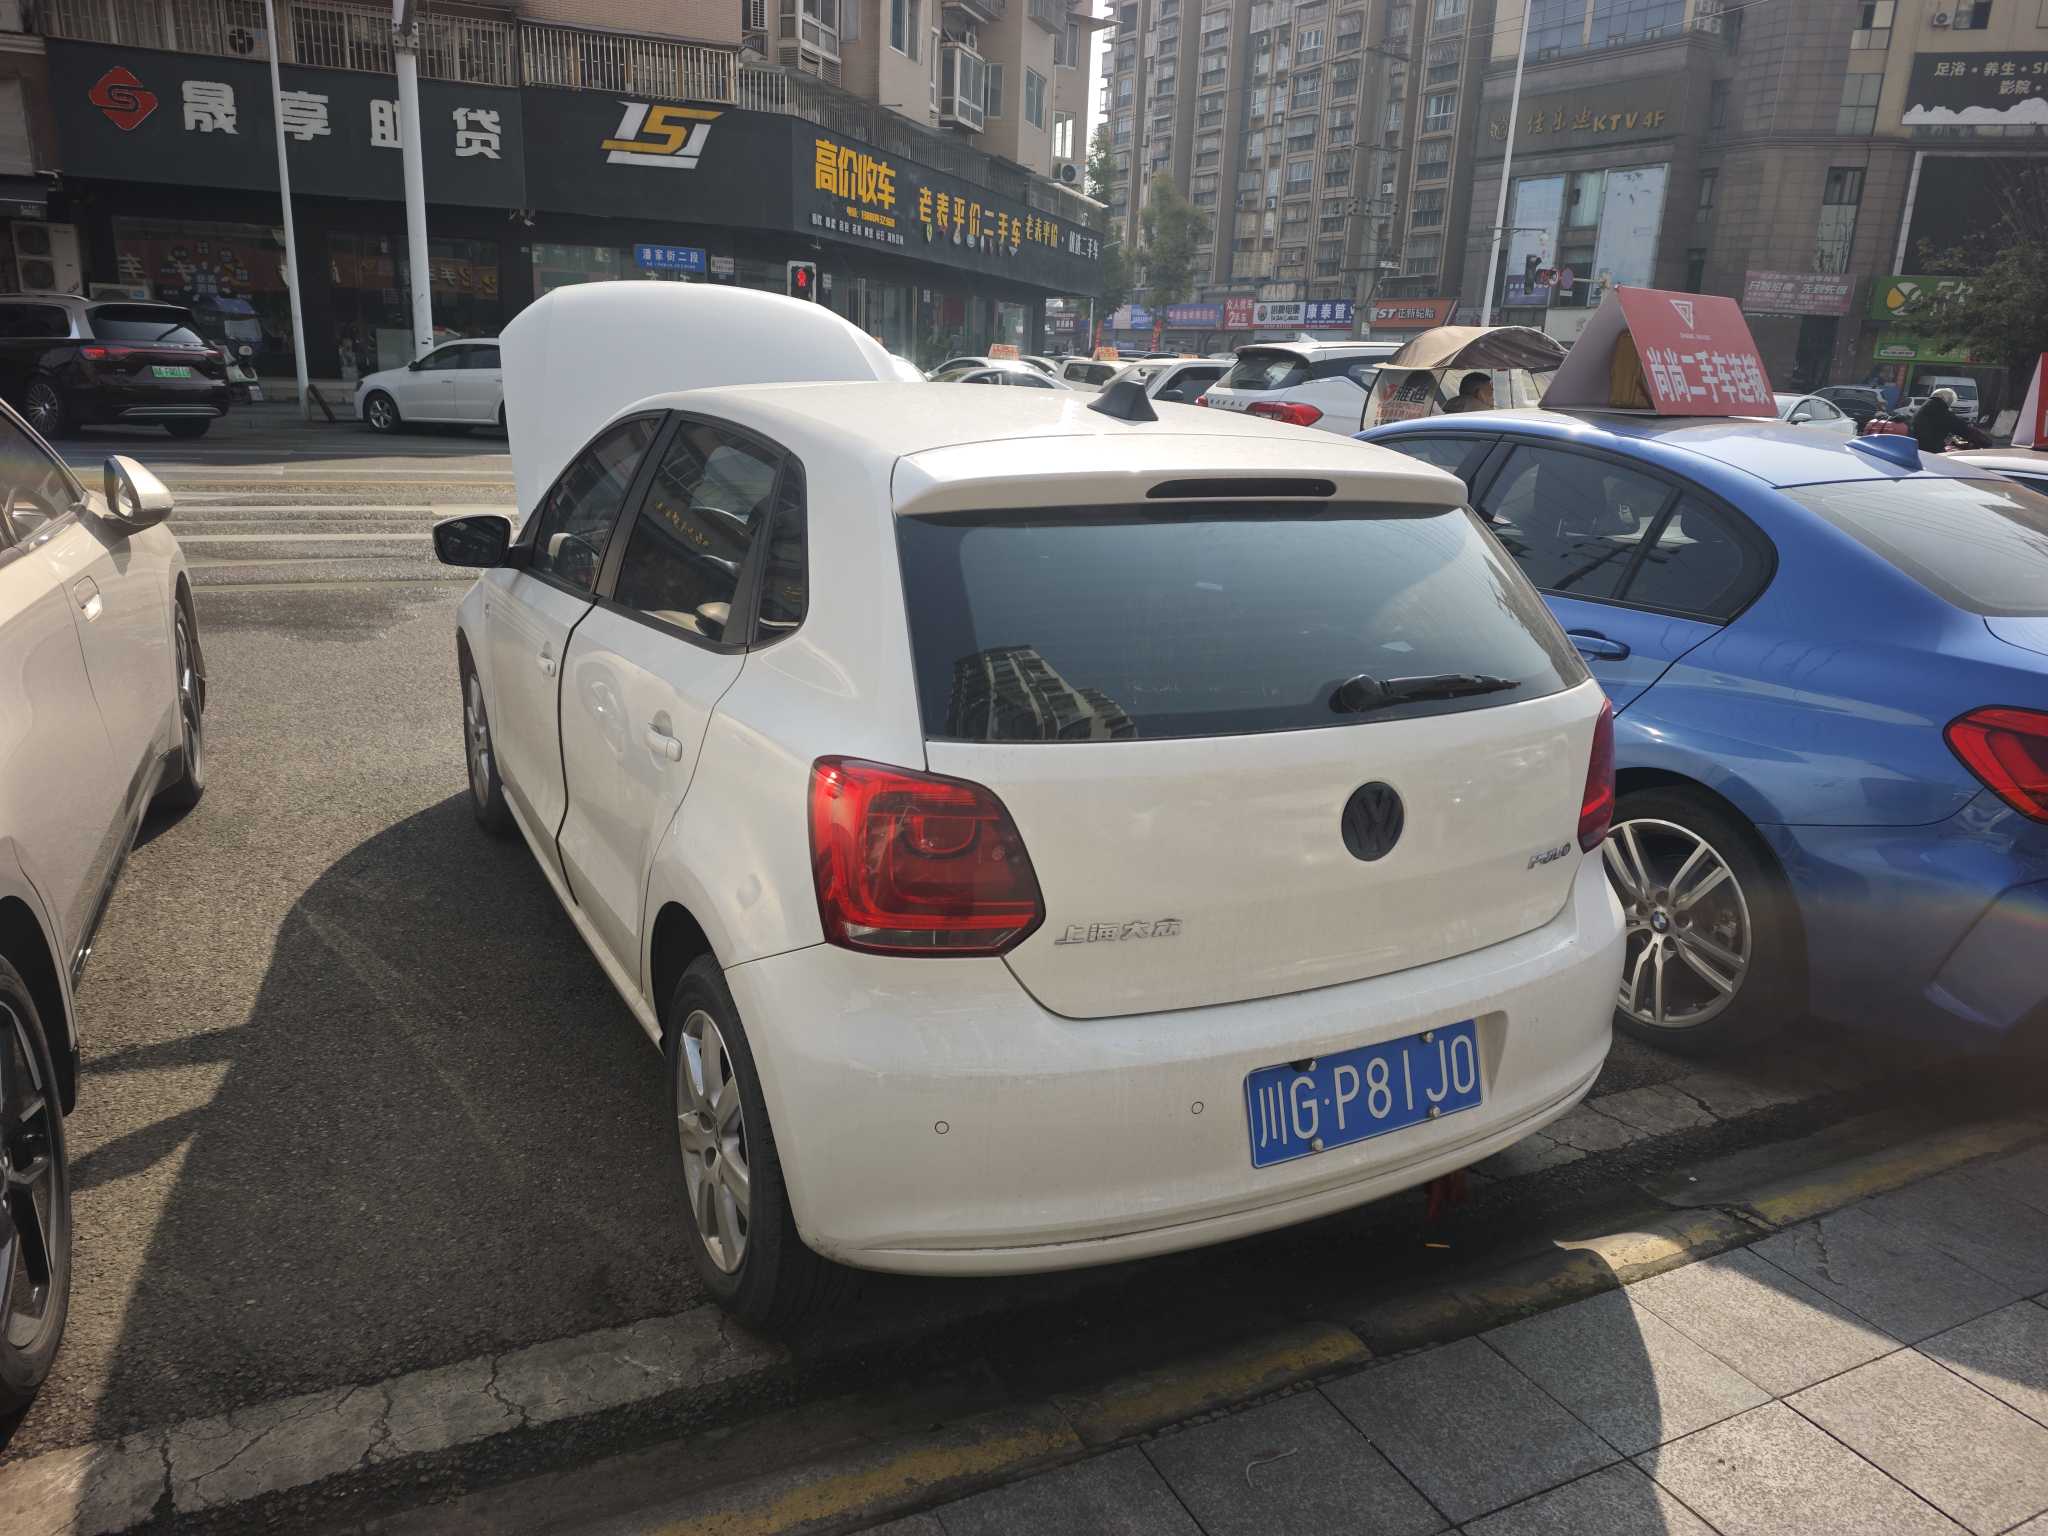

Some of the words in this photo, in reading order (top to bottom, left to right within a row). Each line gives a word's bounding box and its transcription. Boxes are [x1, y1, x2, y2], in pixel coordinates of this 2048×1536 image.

[814, 138, 897, 210] 高价收车
[919, 187, 1022, 249] 老表平价二手车
[1646, 346, 1770, 404] 尚尚二手车连锁
[1054, 918, 1184, 946] 上海大众
